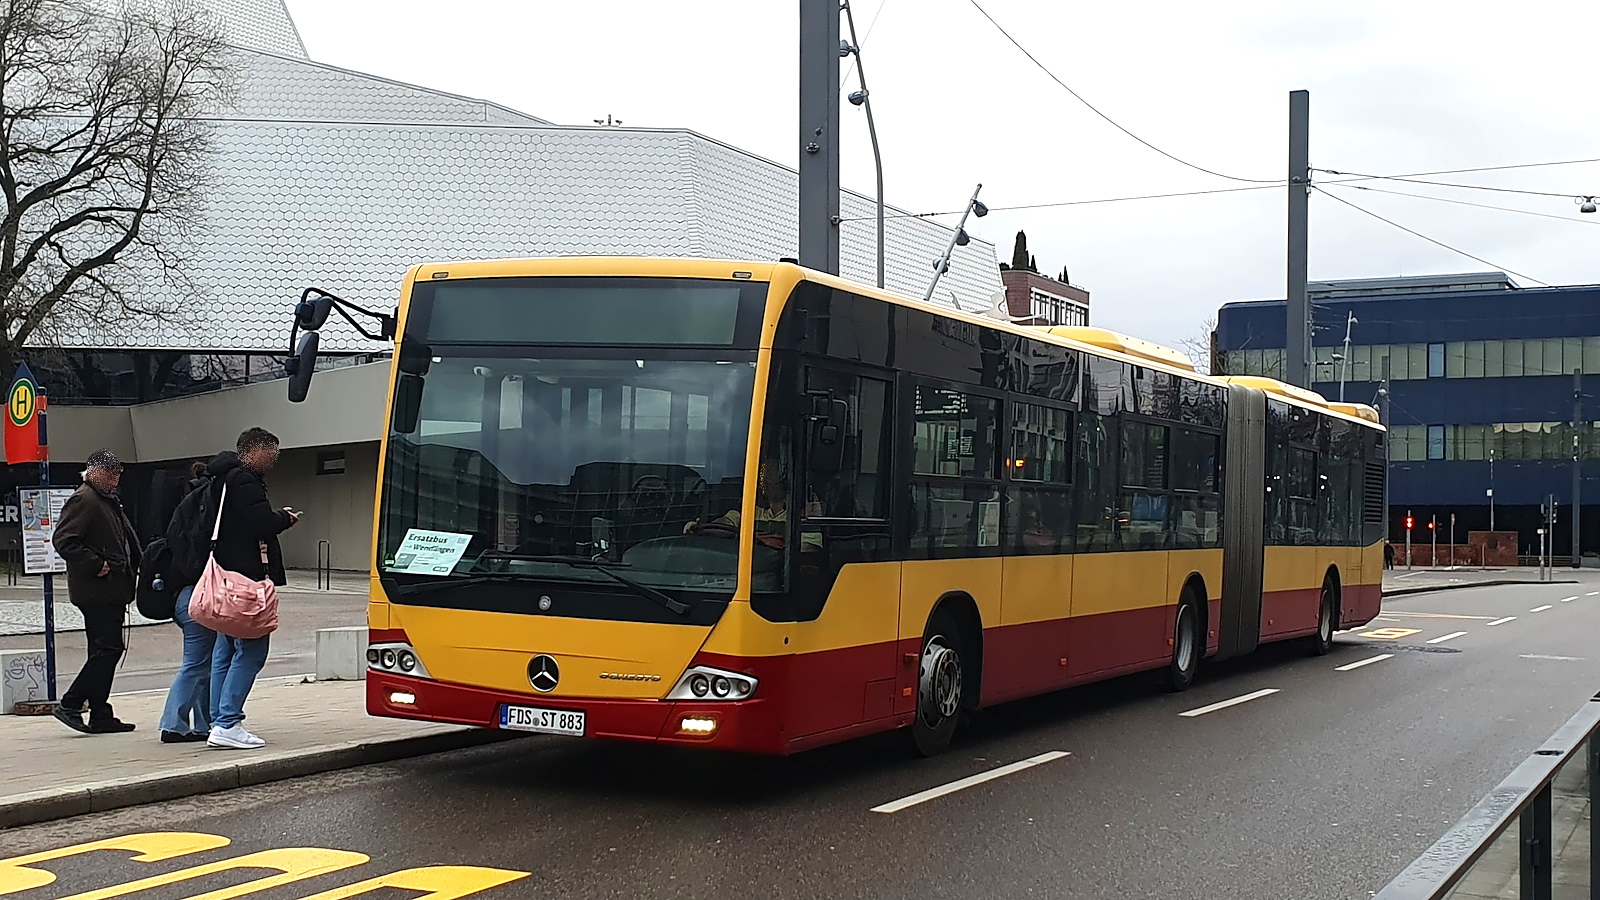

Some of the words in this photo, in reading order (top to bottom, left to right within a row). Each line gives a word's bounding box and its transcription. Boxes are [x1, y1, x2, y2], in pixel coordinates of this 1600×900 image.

[16, 389, 27, 416] H
[408, 533, 448, 544] Ersatzbus
[508, 708, 531, 725] FDS
[541, 712, 557, 728] ST
[559, 714, 583, 731] 883
